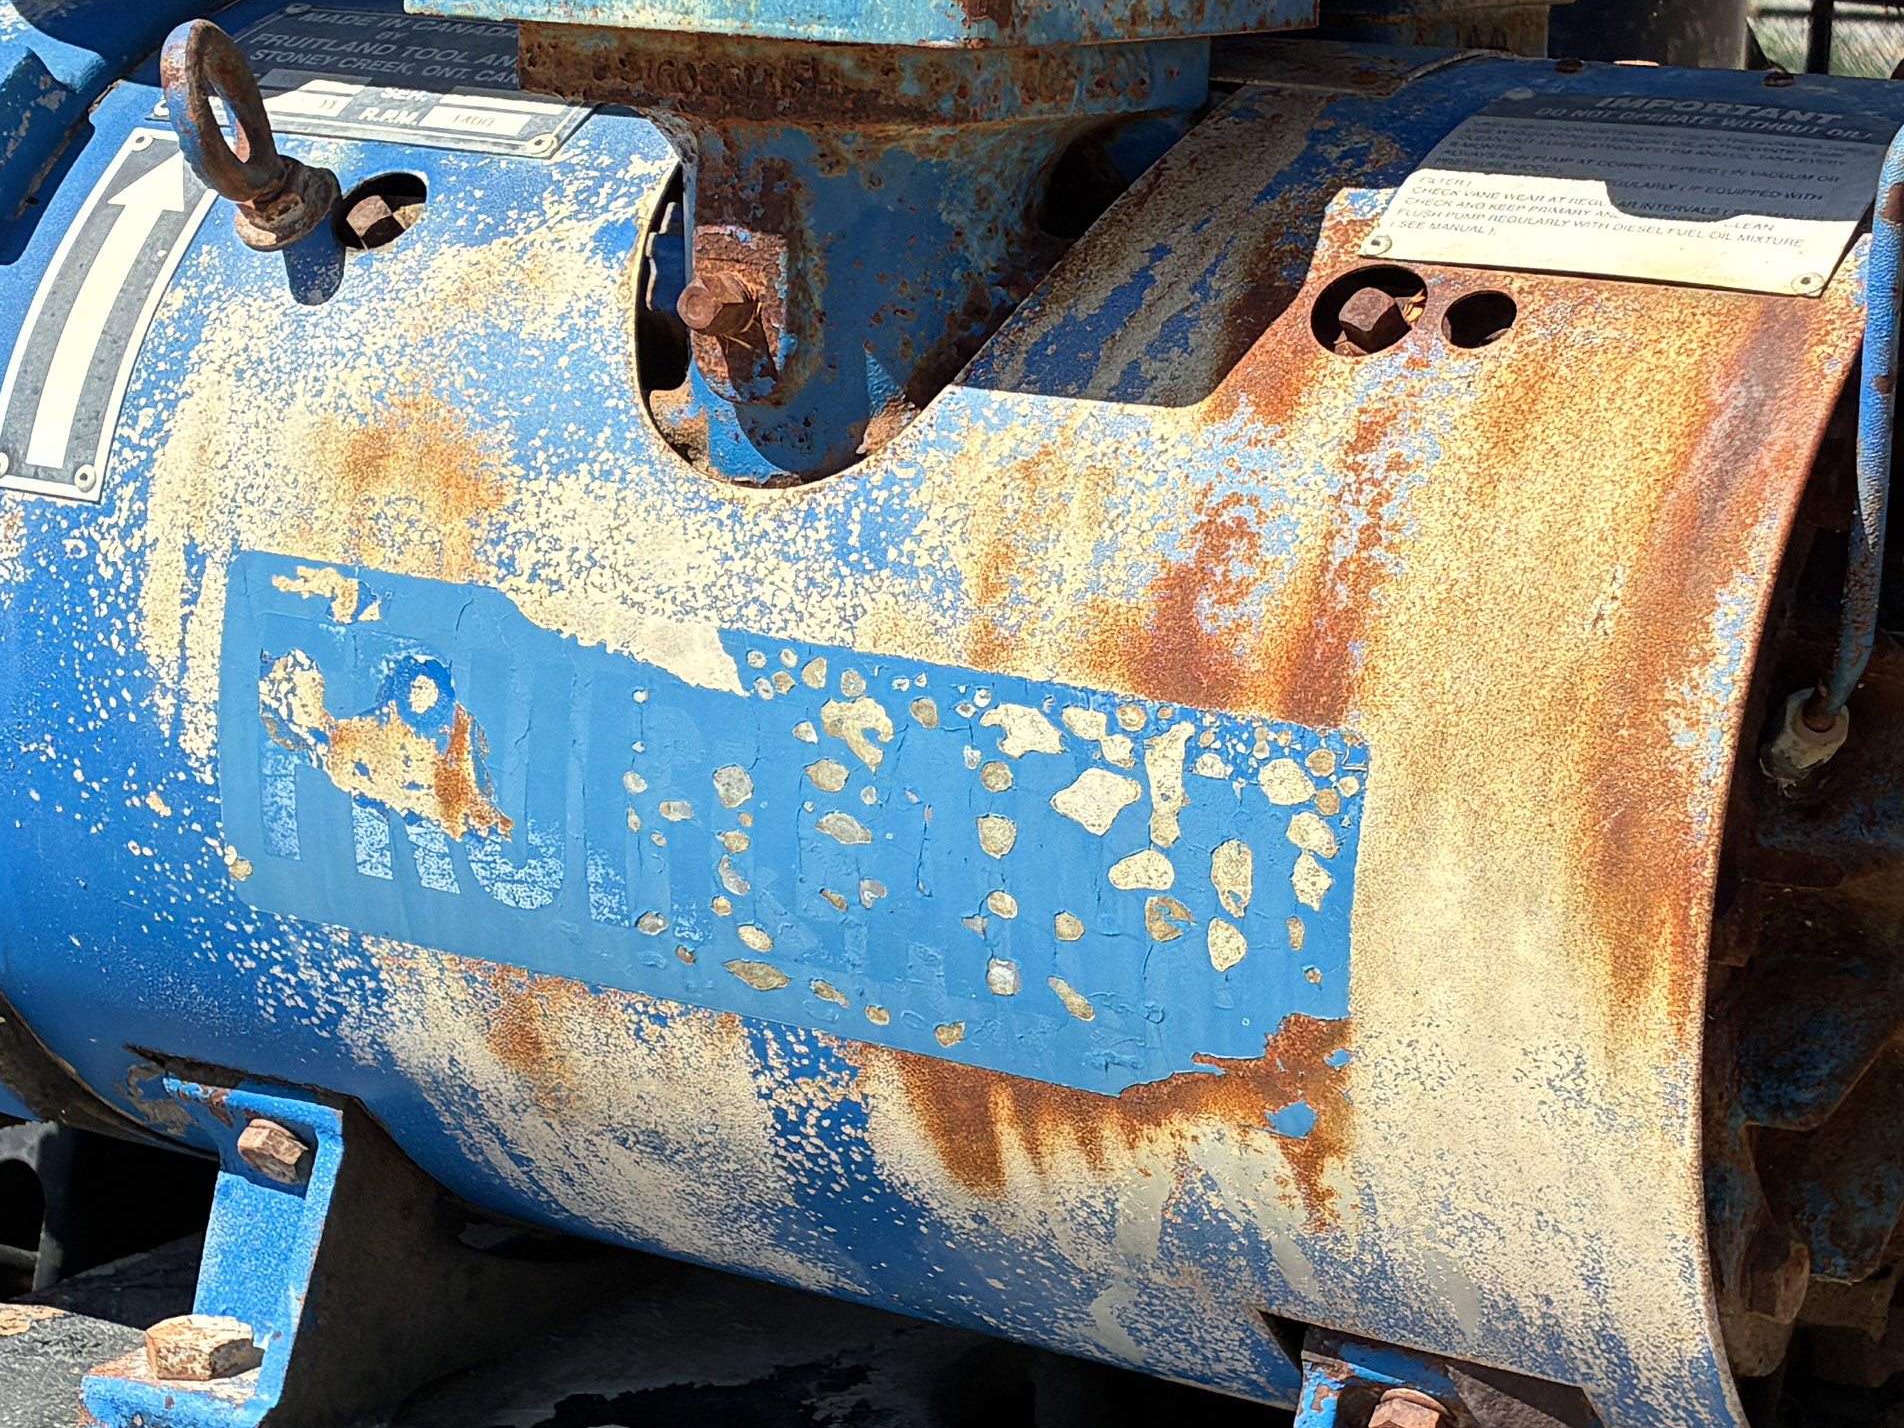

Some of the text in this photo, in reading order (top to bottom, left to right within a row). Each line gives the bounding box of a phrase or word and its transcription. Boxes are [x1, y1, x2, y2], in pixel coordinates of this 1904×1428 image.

[298, 12, 519, 39] MADE IN CANADA
[375, 31, 410, 42] BY
[249, 32, 519, 68] FRUITLAND TOOL AN
[249, 48, 340, 67] STONEY
[357, 106, 421, 126] R.P.M.
[1595, 96, 1844, 124] IMPORTANT
[1534, 107, 1568, 117] DO
[1570, 109, 1614, 119] NOT
[1617, 110, 1718, 125] OPERATE
[1720, 117, 1820, 135] WITHOUT
[1749, 170, 1815, 182] VACUUM
[1412, 186, 1459, 197] CHECK
[1463, 190, 1500, 200] VANE
[1504, 193, 1546, 203] WEAR
[1547, 196, 1567, 204] AT
[1638, 202, 1720, 216] INTERVALS
[1705, 185, 1784, 200] EQUIPPED
[1783, 191, 1824, 201] WITH
[1403, 197, 1452, 208] CHECK
[1455, 201, 1486, 211] AND
[1487, 203, 1527, 213] KEEP
[1527, 204, 1592, 217] PRIMARY
[1396, 208, 1805, 248] FLUSH PUMP REGULARLY WITH DIESEL FUEL OIL MIXTURE
[1398, 220, 1426, 230] SEE
[1429, 222, 1487, 234] MANUAL
